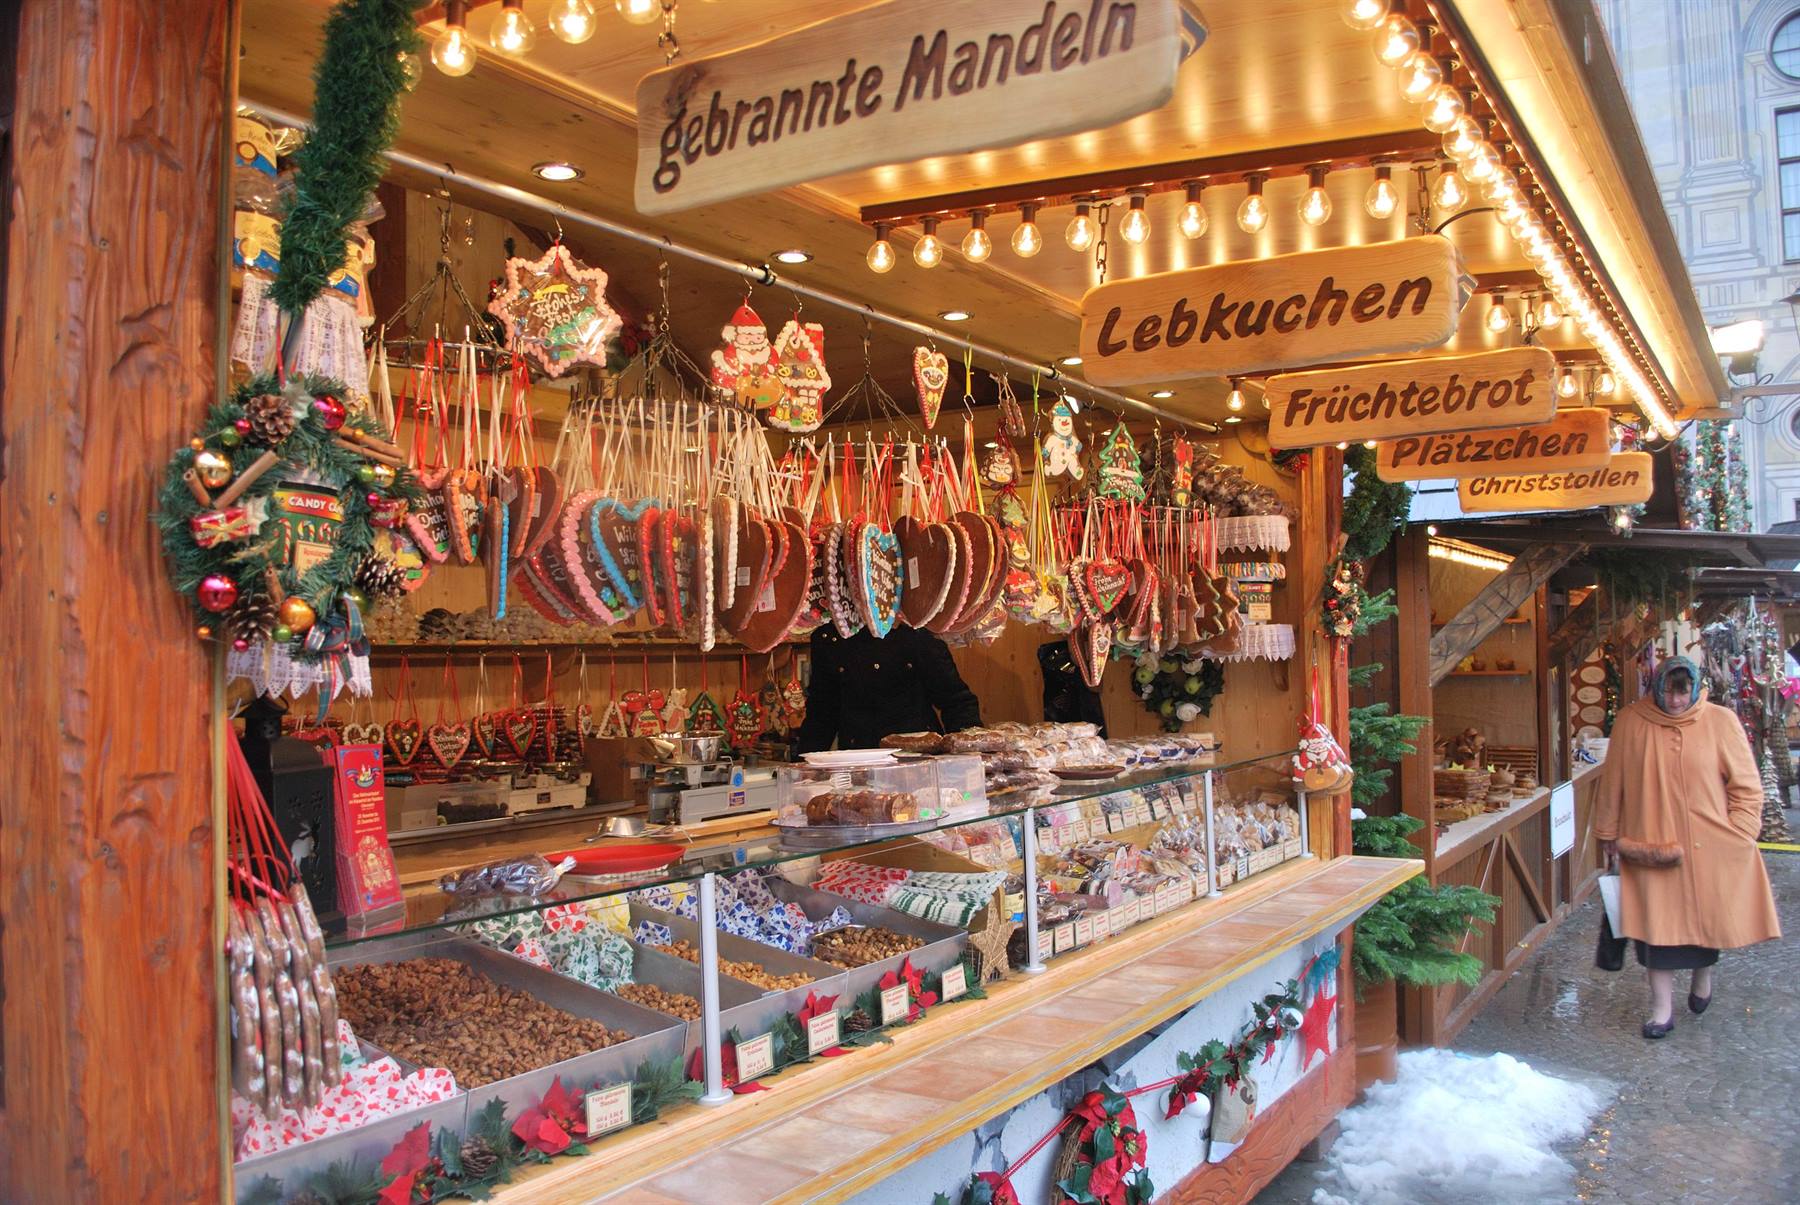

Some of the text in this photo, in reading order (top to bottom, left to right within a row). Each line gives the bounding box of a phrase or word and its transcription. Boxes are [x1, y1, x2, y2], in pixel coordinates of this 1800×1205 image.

[652, 0, 1137, 194] gebrannte Mandeln
[1097, 276, 1433, 357] Lebkuchen
[1283, 368, 1536, 427] Früchtebrot
[1391, 429, 1589, 469] Plätzchen
[287, 495, 326, 510] CANDY
[1469, 467, 1640, 496] Christstollen
